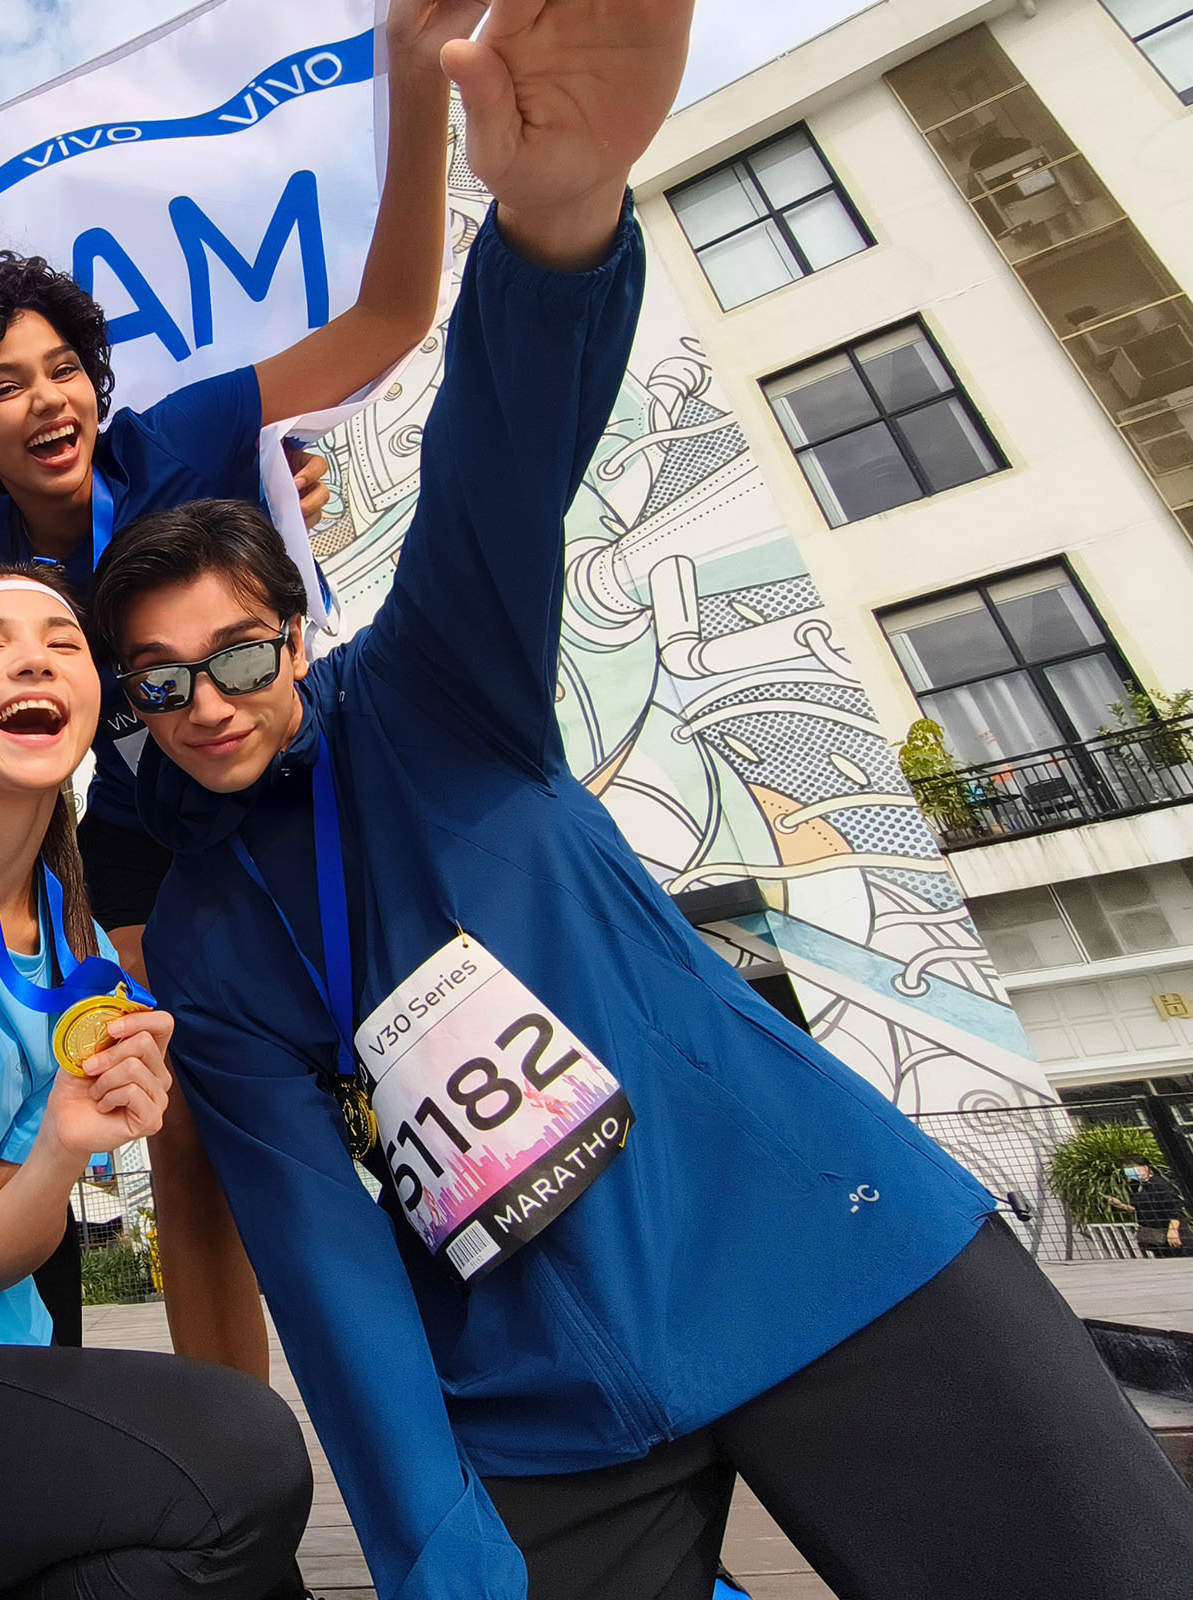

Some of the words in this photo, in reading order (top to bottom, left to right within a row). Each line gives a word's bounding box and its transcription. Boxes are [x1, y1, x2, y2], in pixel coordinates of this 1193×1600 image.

[22, 127, 143, 169] vivo
[219, 52, 343, 126] vivo
[107, 711, 138, 731] viv
[369, 1014, 412, 1057] V30
[408, 961, 478, 1018] Series
[387, 1012, 582, 1212] 51182
[495, 1117, 619, 1233] MARATHO
